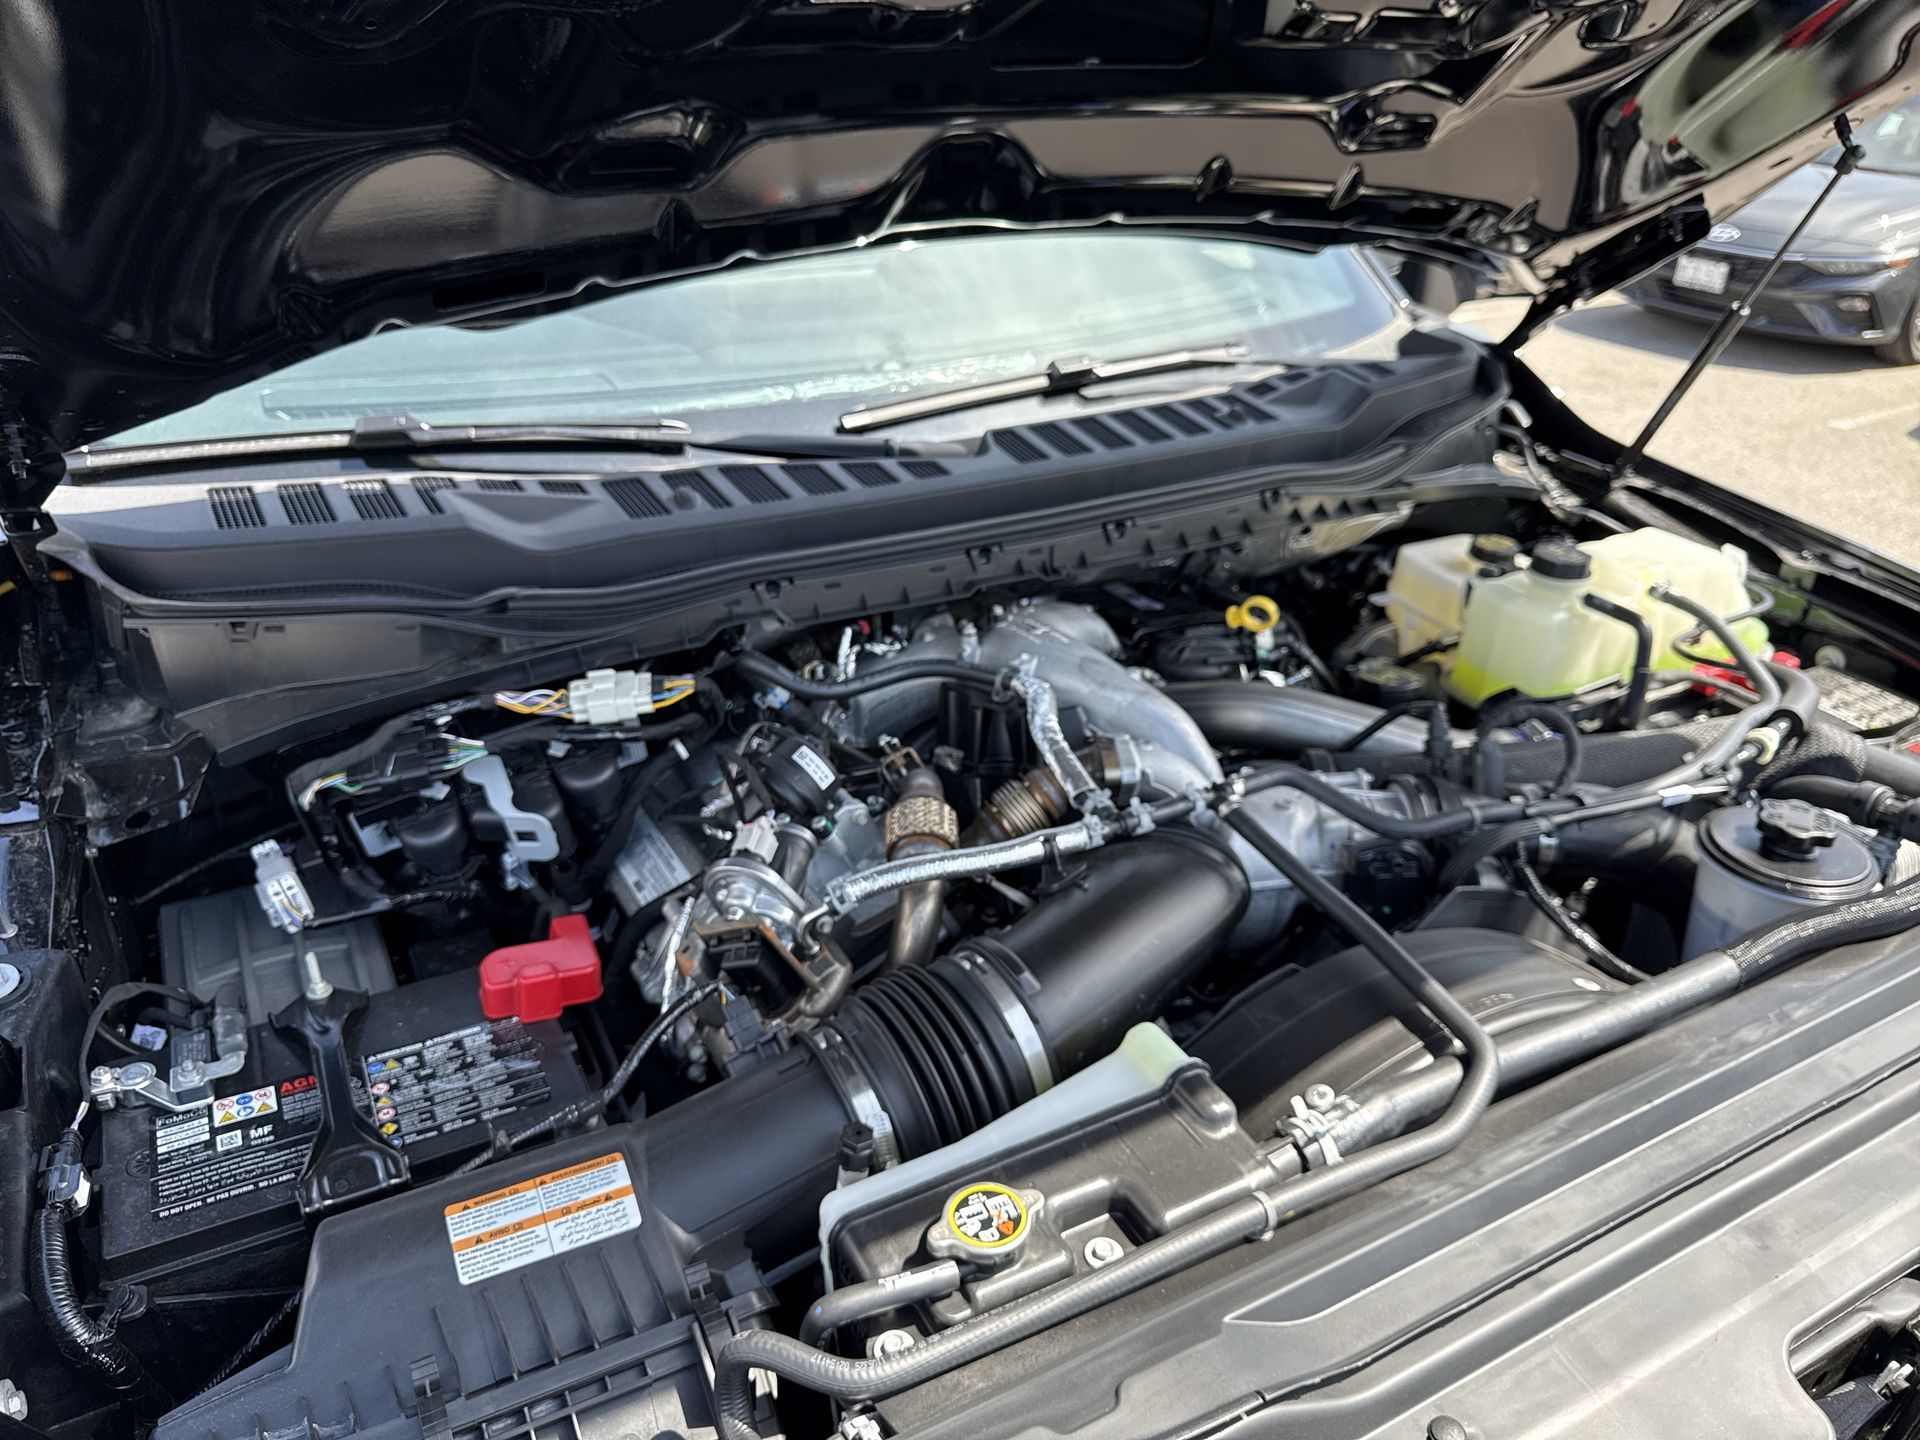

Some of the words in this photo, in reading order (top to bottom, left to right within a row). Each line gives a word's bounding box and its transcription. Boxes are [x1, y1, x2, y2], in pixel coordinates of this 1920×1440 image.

[158, 1107, 206, 1126] FoMoCo
[250, 1124, 273, 1138] MF
[160, 1210, 169, 1218] DO
[170, 1206, 183, 1214] NOT
[217, 1192, 229, 1200] PAS
[279, 1173, 295, 1182] ABRA
[490, 1226, 510, 1238] AVISO
